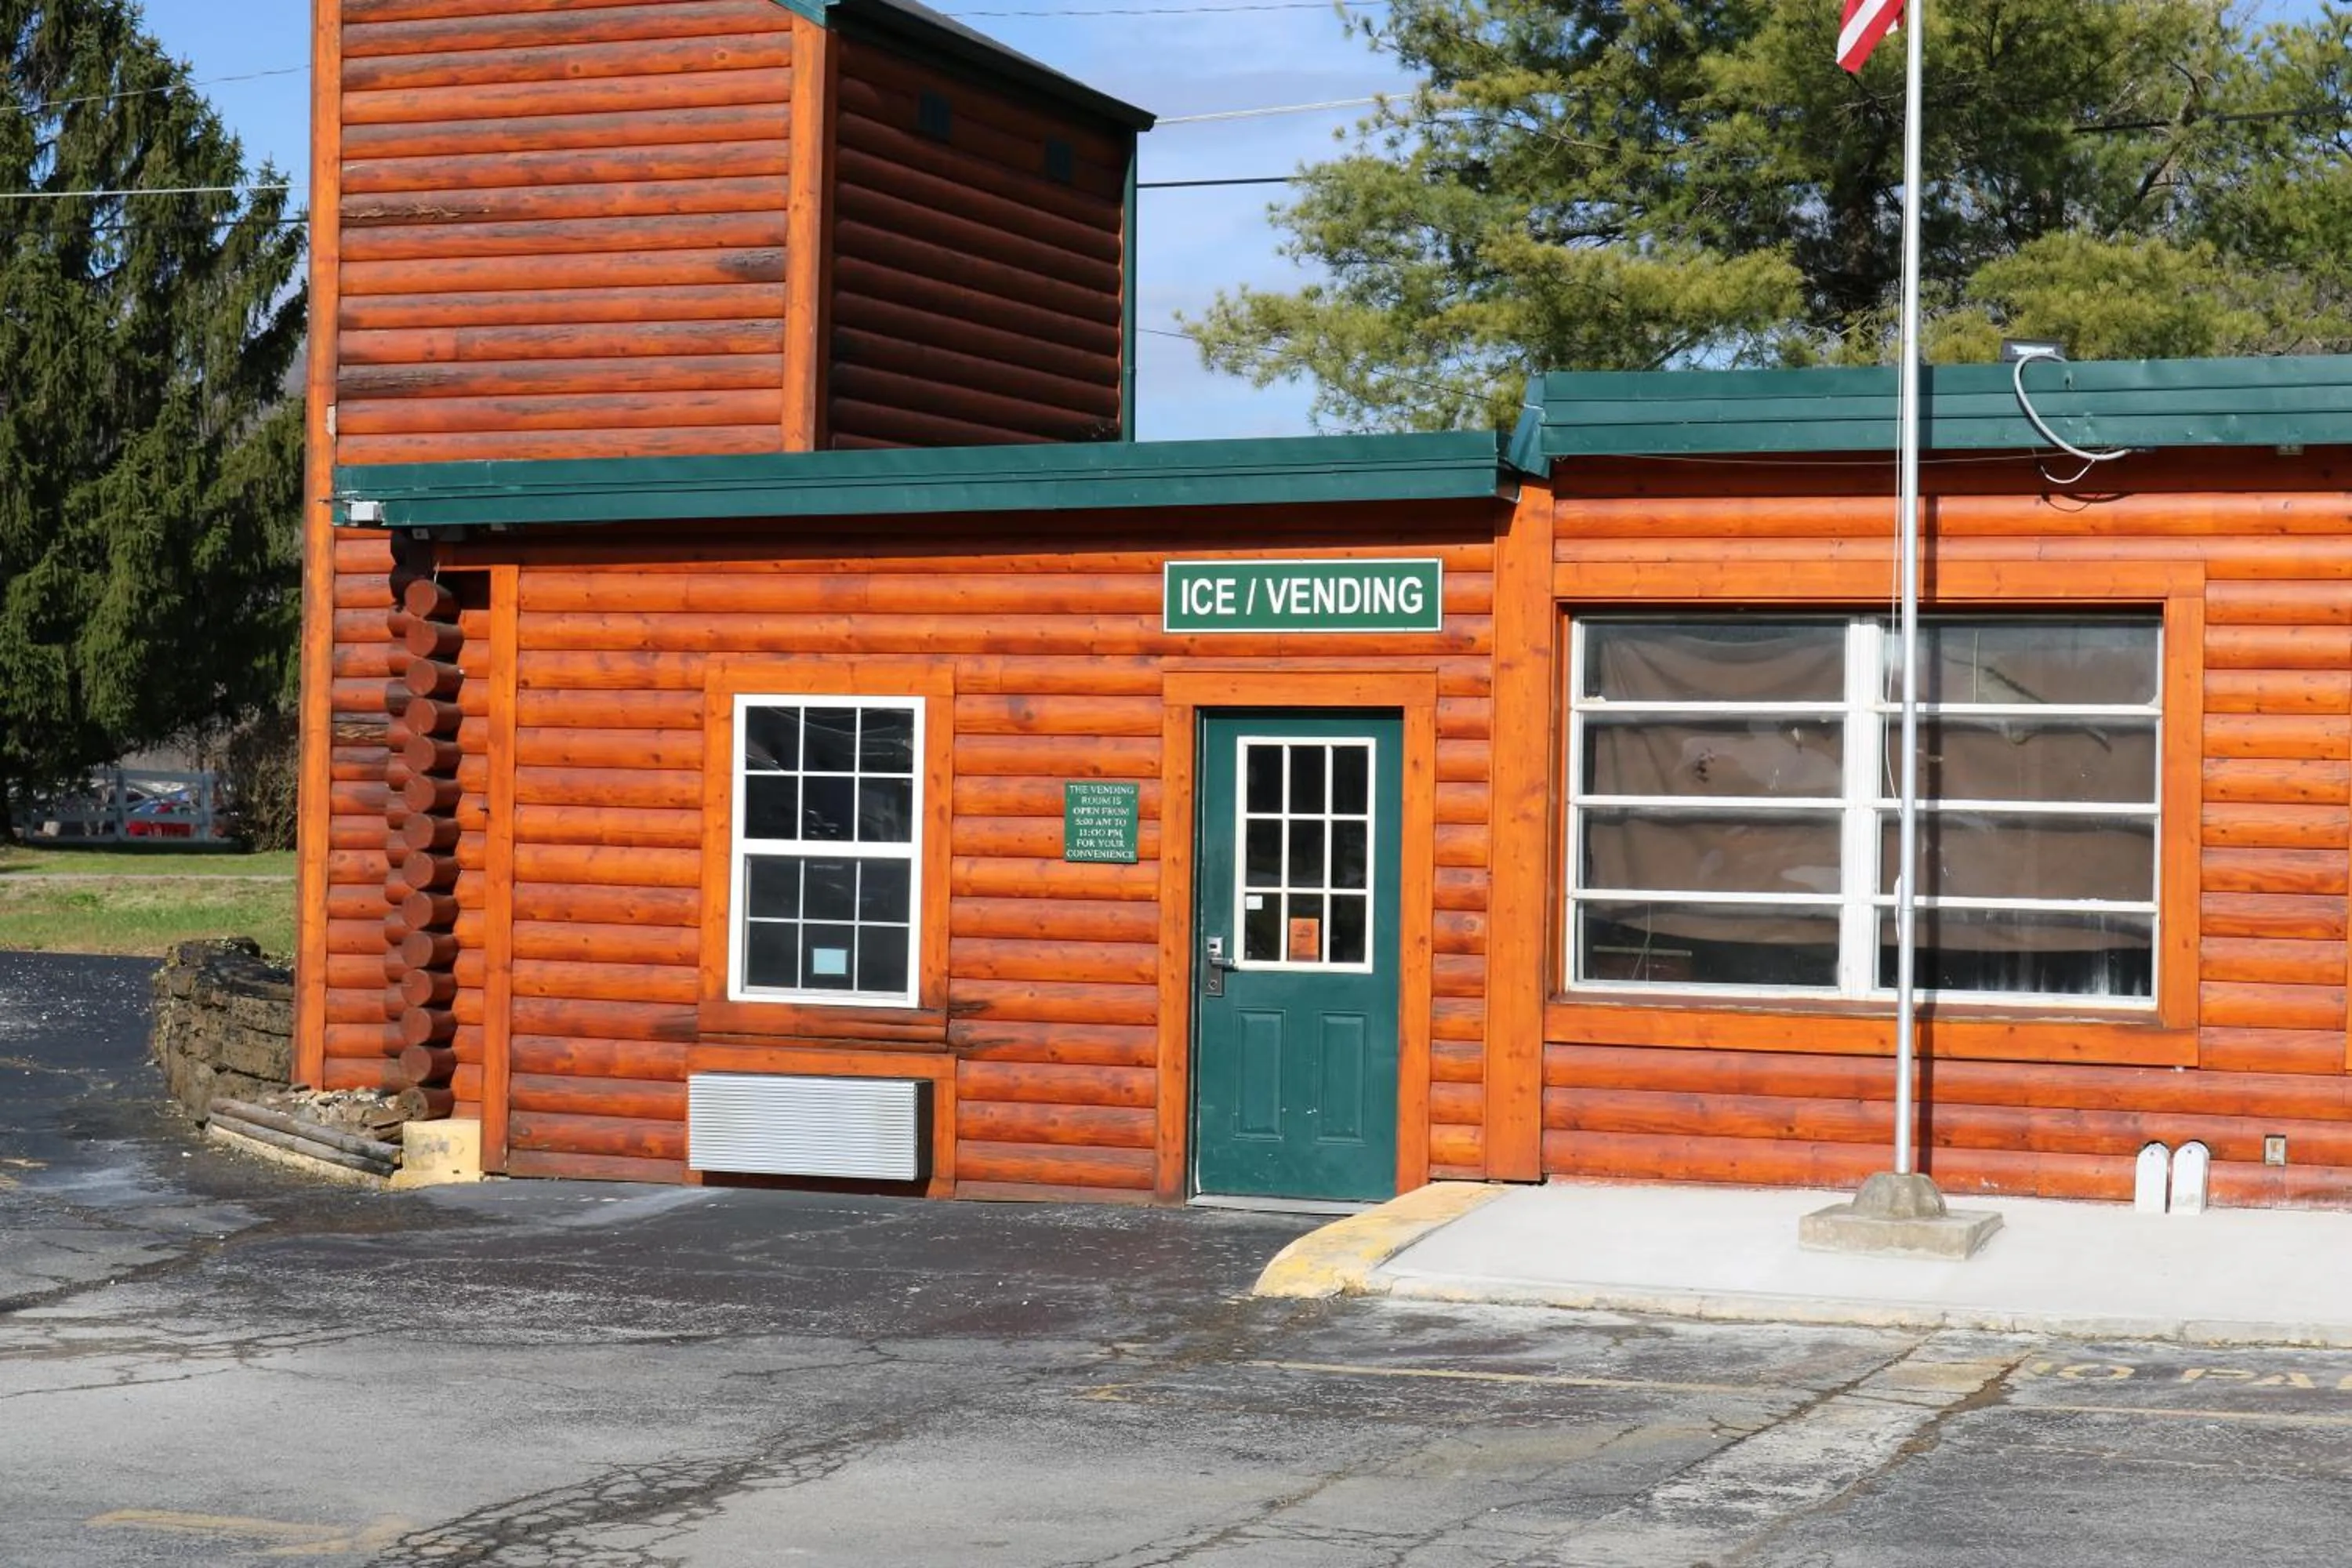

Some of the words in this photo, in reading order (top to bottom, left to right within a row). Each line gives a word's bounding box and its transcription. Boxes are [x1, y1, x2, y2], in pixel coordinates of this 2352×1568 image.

[1181, 578, 1236, 615] ICE
[1246, 578, 1257, 615] /
[1265, 576, 1424, 615] VENDING
[1069, 785, 1088, 794] THE
[1091, 785, 1134, 794] VENDING
[1081, 796, 1111, 805] ROOM
[1112, 796, 1122, 805] IS
[1102, 807, 1130, 816] FROM
[1115, 818, 1127, 827] TO
[1079, 828, 1106, 837] 11:00
[1076, 839, 1095, 848] FOR
[1098, 839, 1125, 848] YOUR
[1066, 848, 1134, 858] CONVENIENCE
[2178, 1369, 2352, 1389] PA
